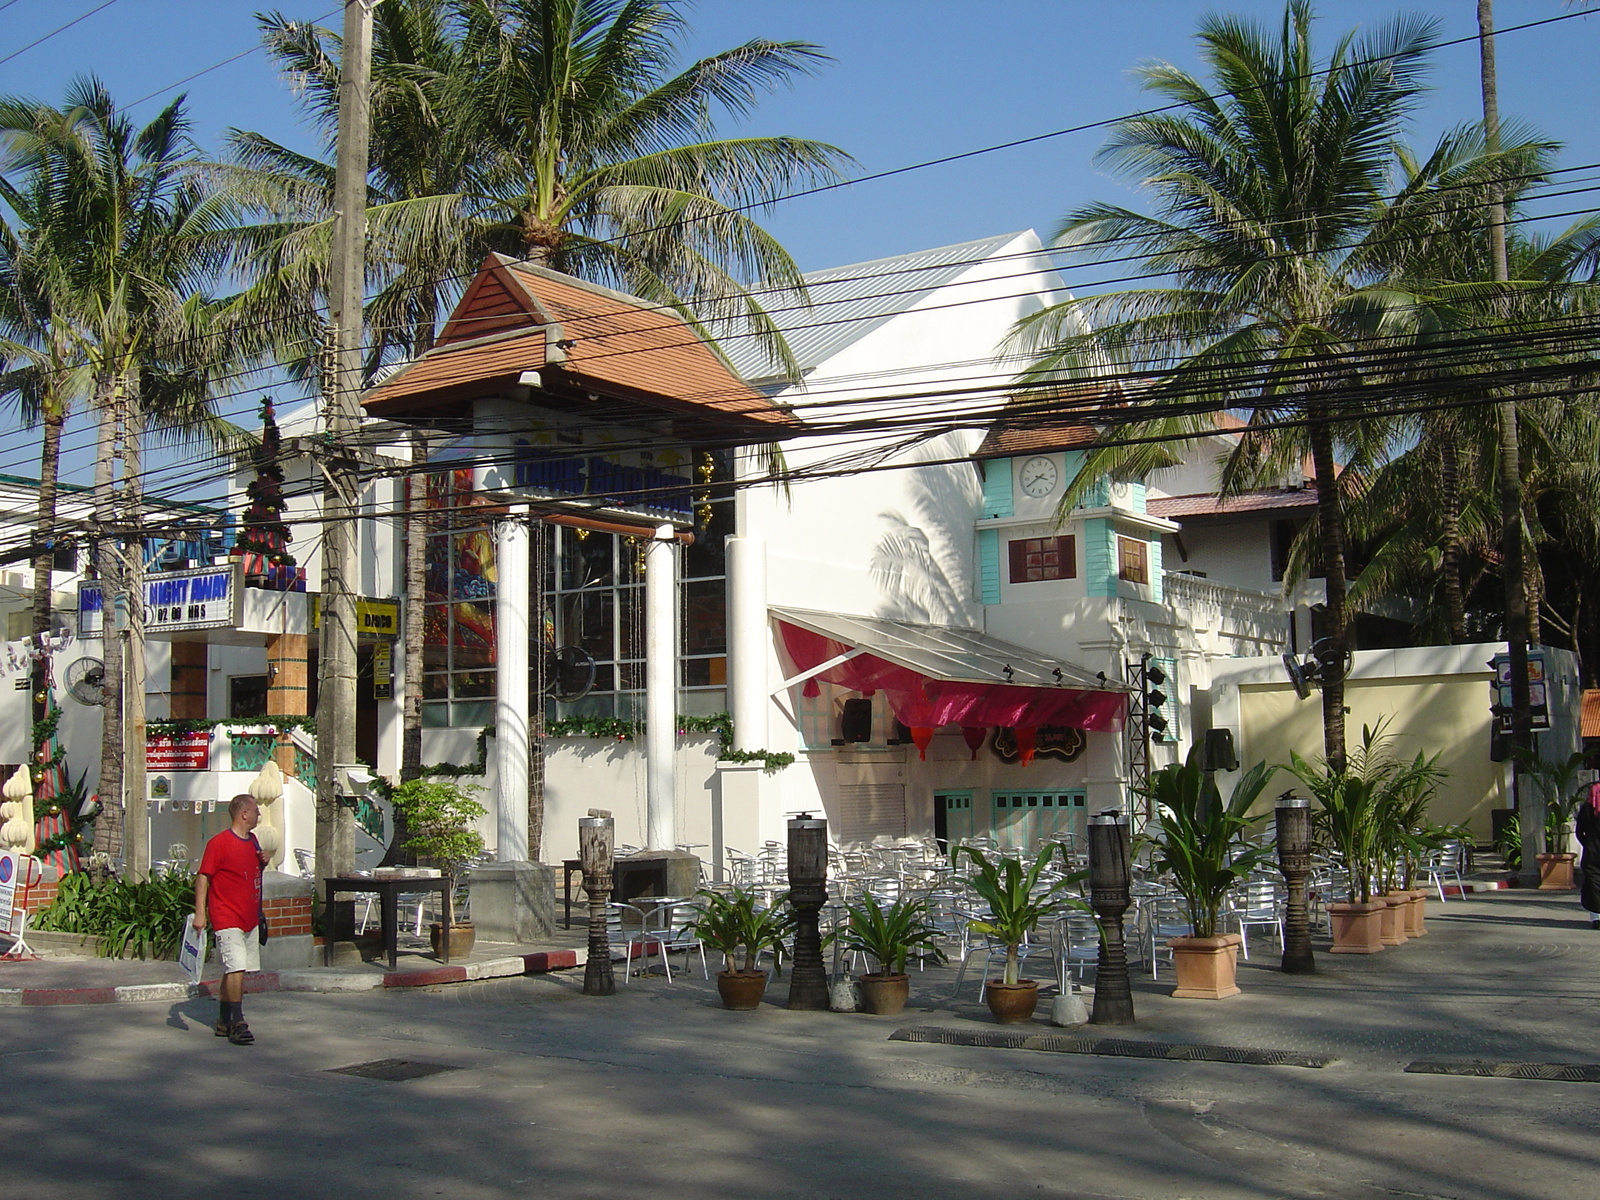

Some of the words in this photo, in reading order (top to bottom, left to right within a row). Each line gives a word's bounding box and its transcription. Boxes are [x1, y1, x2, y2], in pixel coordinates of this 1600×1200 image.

[149, 579, 189, 605] NIGHT
[190, 573, 231, 601] AWAY
[188, 604, 206, 620] HRS
[364, 613, 392, 628] DISCO
